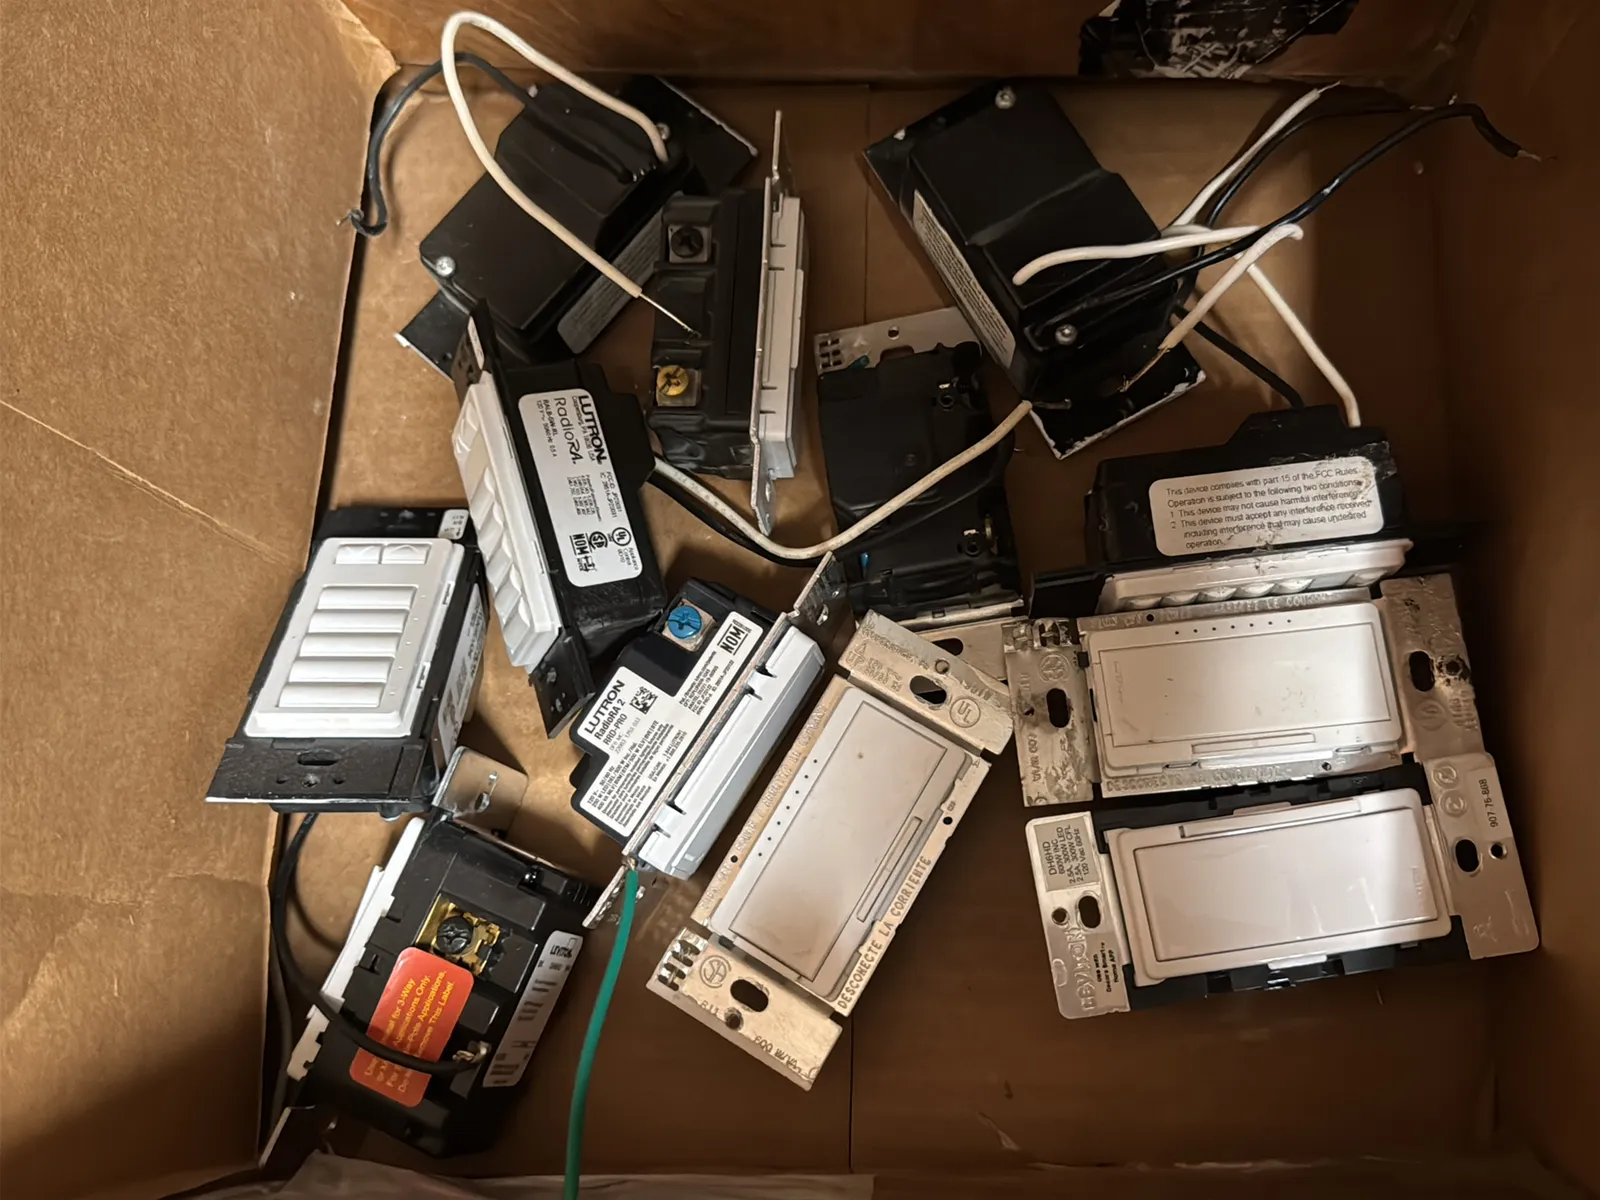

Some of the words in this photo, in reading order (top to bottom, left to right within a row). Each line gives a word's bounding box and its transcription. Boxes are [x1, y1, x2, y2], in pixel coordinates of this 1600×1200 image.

[1166, 487, 1182, 495] This
[1183, 485, 1208, 494] device
[1245, 477, 1260, 486] with
[1262, 476, 1278, 485] part
[1280, 473, 1290, 482] 15
[1291, 472, 1299, 481] of
[1301, 471, 1314, 480] the
[1314, 469, 1333, 478] FCC
[1167, 497, 1205, 507] Operation
[1215, 492, 1242, 501] subject
[1243, 490, 1252, 498] to
[1253, 488, 1266, 497] the
[1267, 485, 1301, 495] following
[1303, 483, 1317, 491] two
[1178, 508, 1195, 517] This
[1196, 506, 1221, 515] device
[1222, 503, 1239, 511] may
[1240, 500, 1253, 509] not
[1254, 499, 1278, 508] cause
[1279, 495, 1309, 504] harmful
[1180, 518, 1197, 527] This
[1197, 516, 1222, 525] device
[1224, 513, 1243, 522] must
[1245, 510, 1271, 520] accept
[1183, 528, 1217, 538] including
[1283, 518, 1300, 526] may
[1302, 515, 1326, 524] cause
[1327, 510, 1366, 522] undesired
[720, 625, 744, 653] NOM
[584, 679, 624, 733] LUTRON
[594, 706, 620, 739] RadioRA
[616, 697, 625, 706] 2
[602, 713, 627, 745] RRD-PRO
[1056, 826, 1065, 842] LED
[1064, 824, 1073, 840] CFL
[1073, 828, 1082, 846] 60Hz
[1050, 838, 1059, 852] INC
[1060, 843, 1070, 863] 300W
[1067, 841, 1078, 861] 300W
[1042, 841, 1057, 875] DH6HD
[1054, 854, 1065, 874] 600W
[1080, 862, 1089, 875] 120
[878, 921, 893, 936] LA
[890, 855, 930, 916] CORRIENTE
[1107, 949, 1115, 962] APP
[1110, 963, 1118, 982] Home
[391, 1005, 401, 1018] for
[397, 978, 415, 1005] 3-Way
[428, 1006, 442, 1023] This
